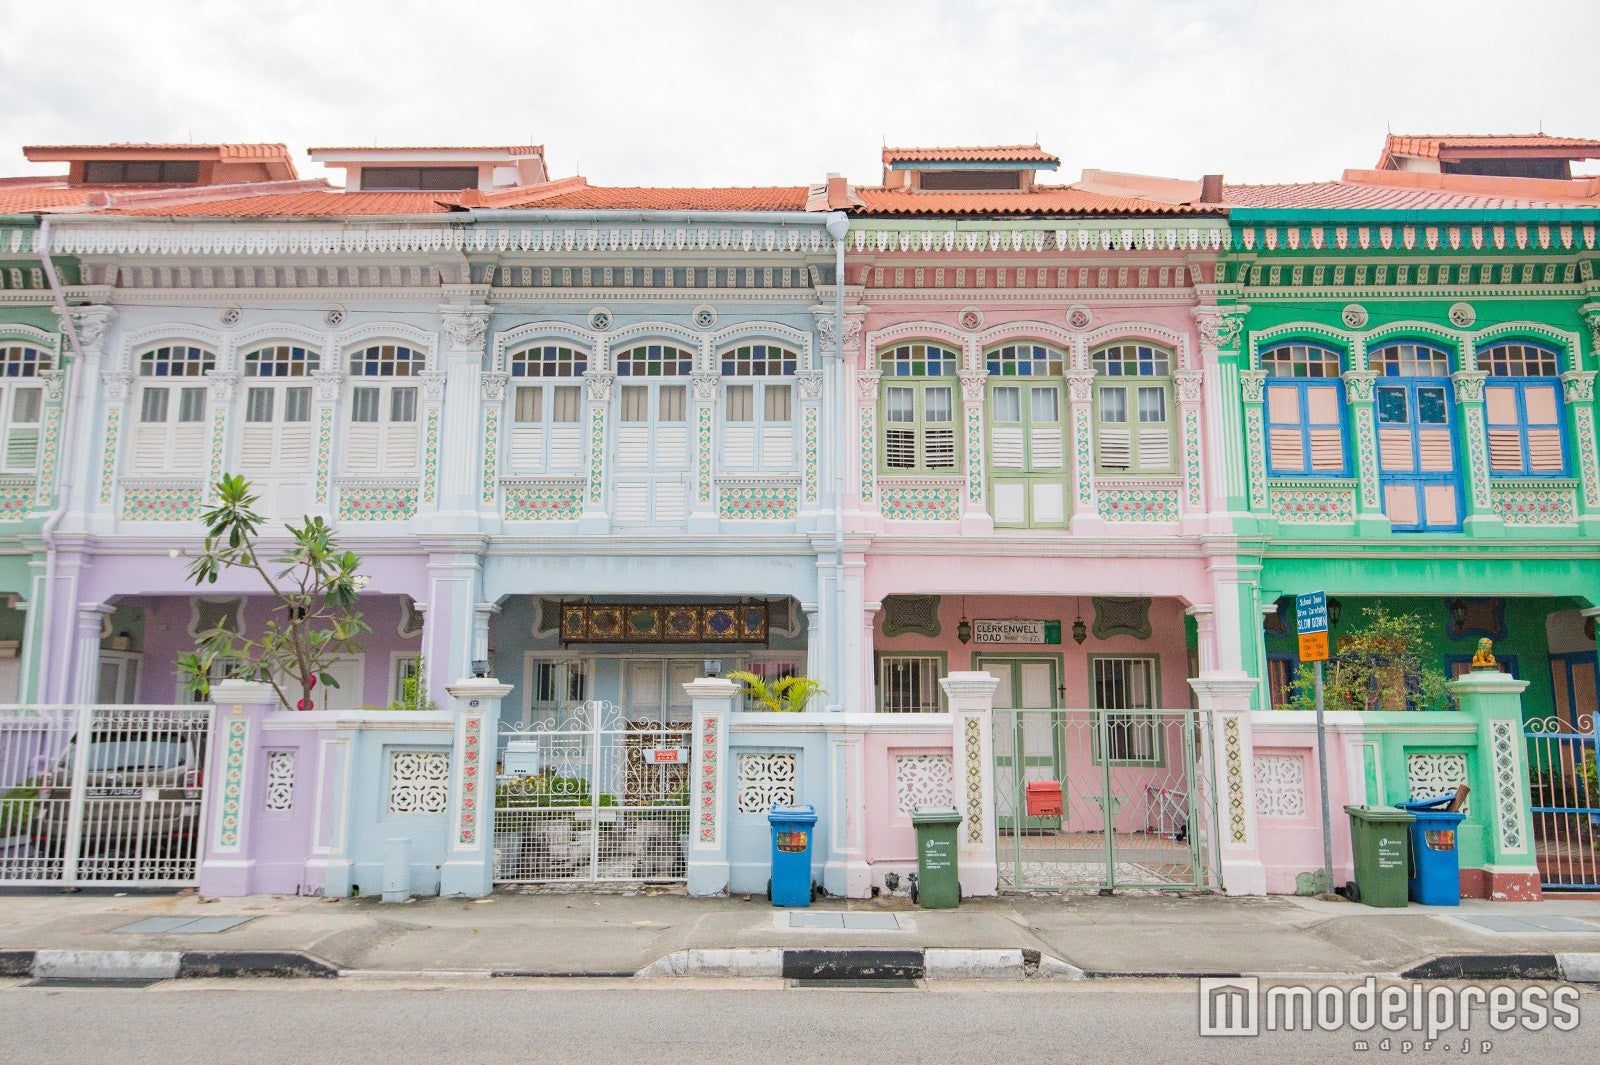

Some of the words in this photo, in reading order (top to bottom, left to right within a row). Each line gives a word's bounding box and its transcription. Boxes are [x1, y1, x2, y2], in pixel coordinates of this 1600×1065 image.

[1298, 618, 1311, 630] SLOW
[1312, 617, 1327, 628] DOWN
[976, 624, 1039, 634] CLERKENWELL
[976, 633, 1002, 642] ROAD
